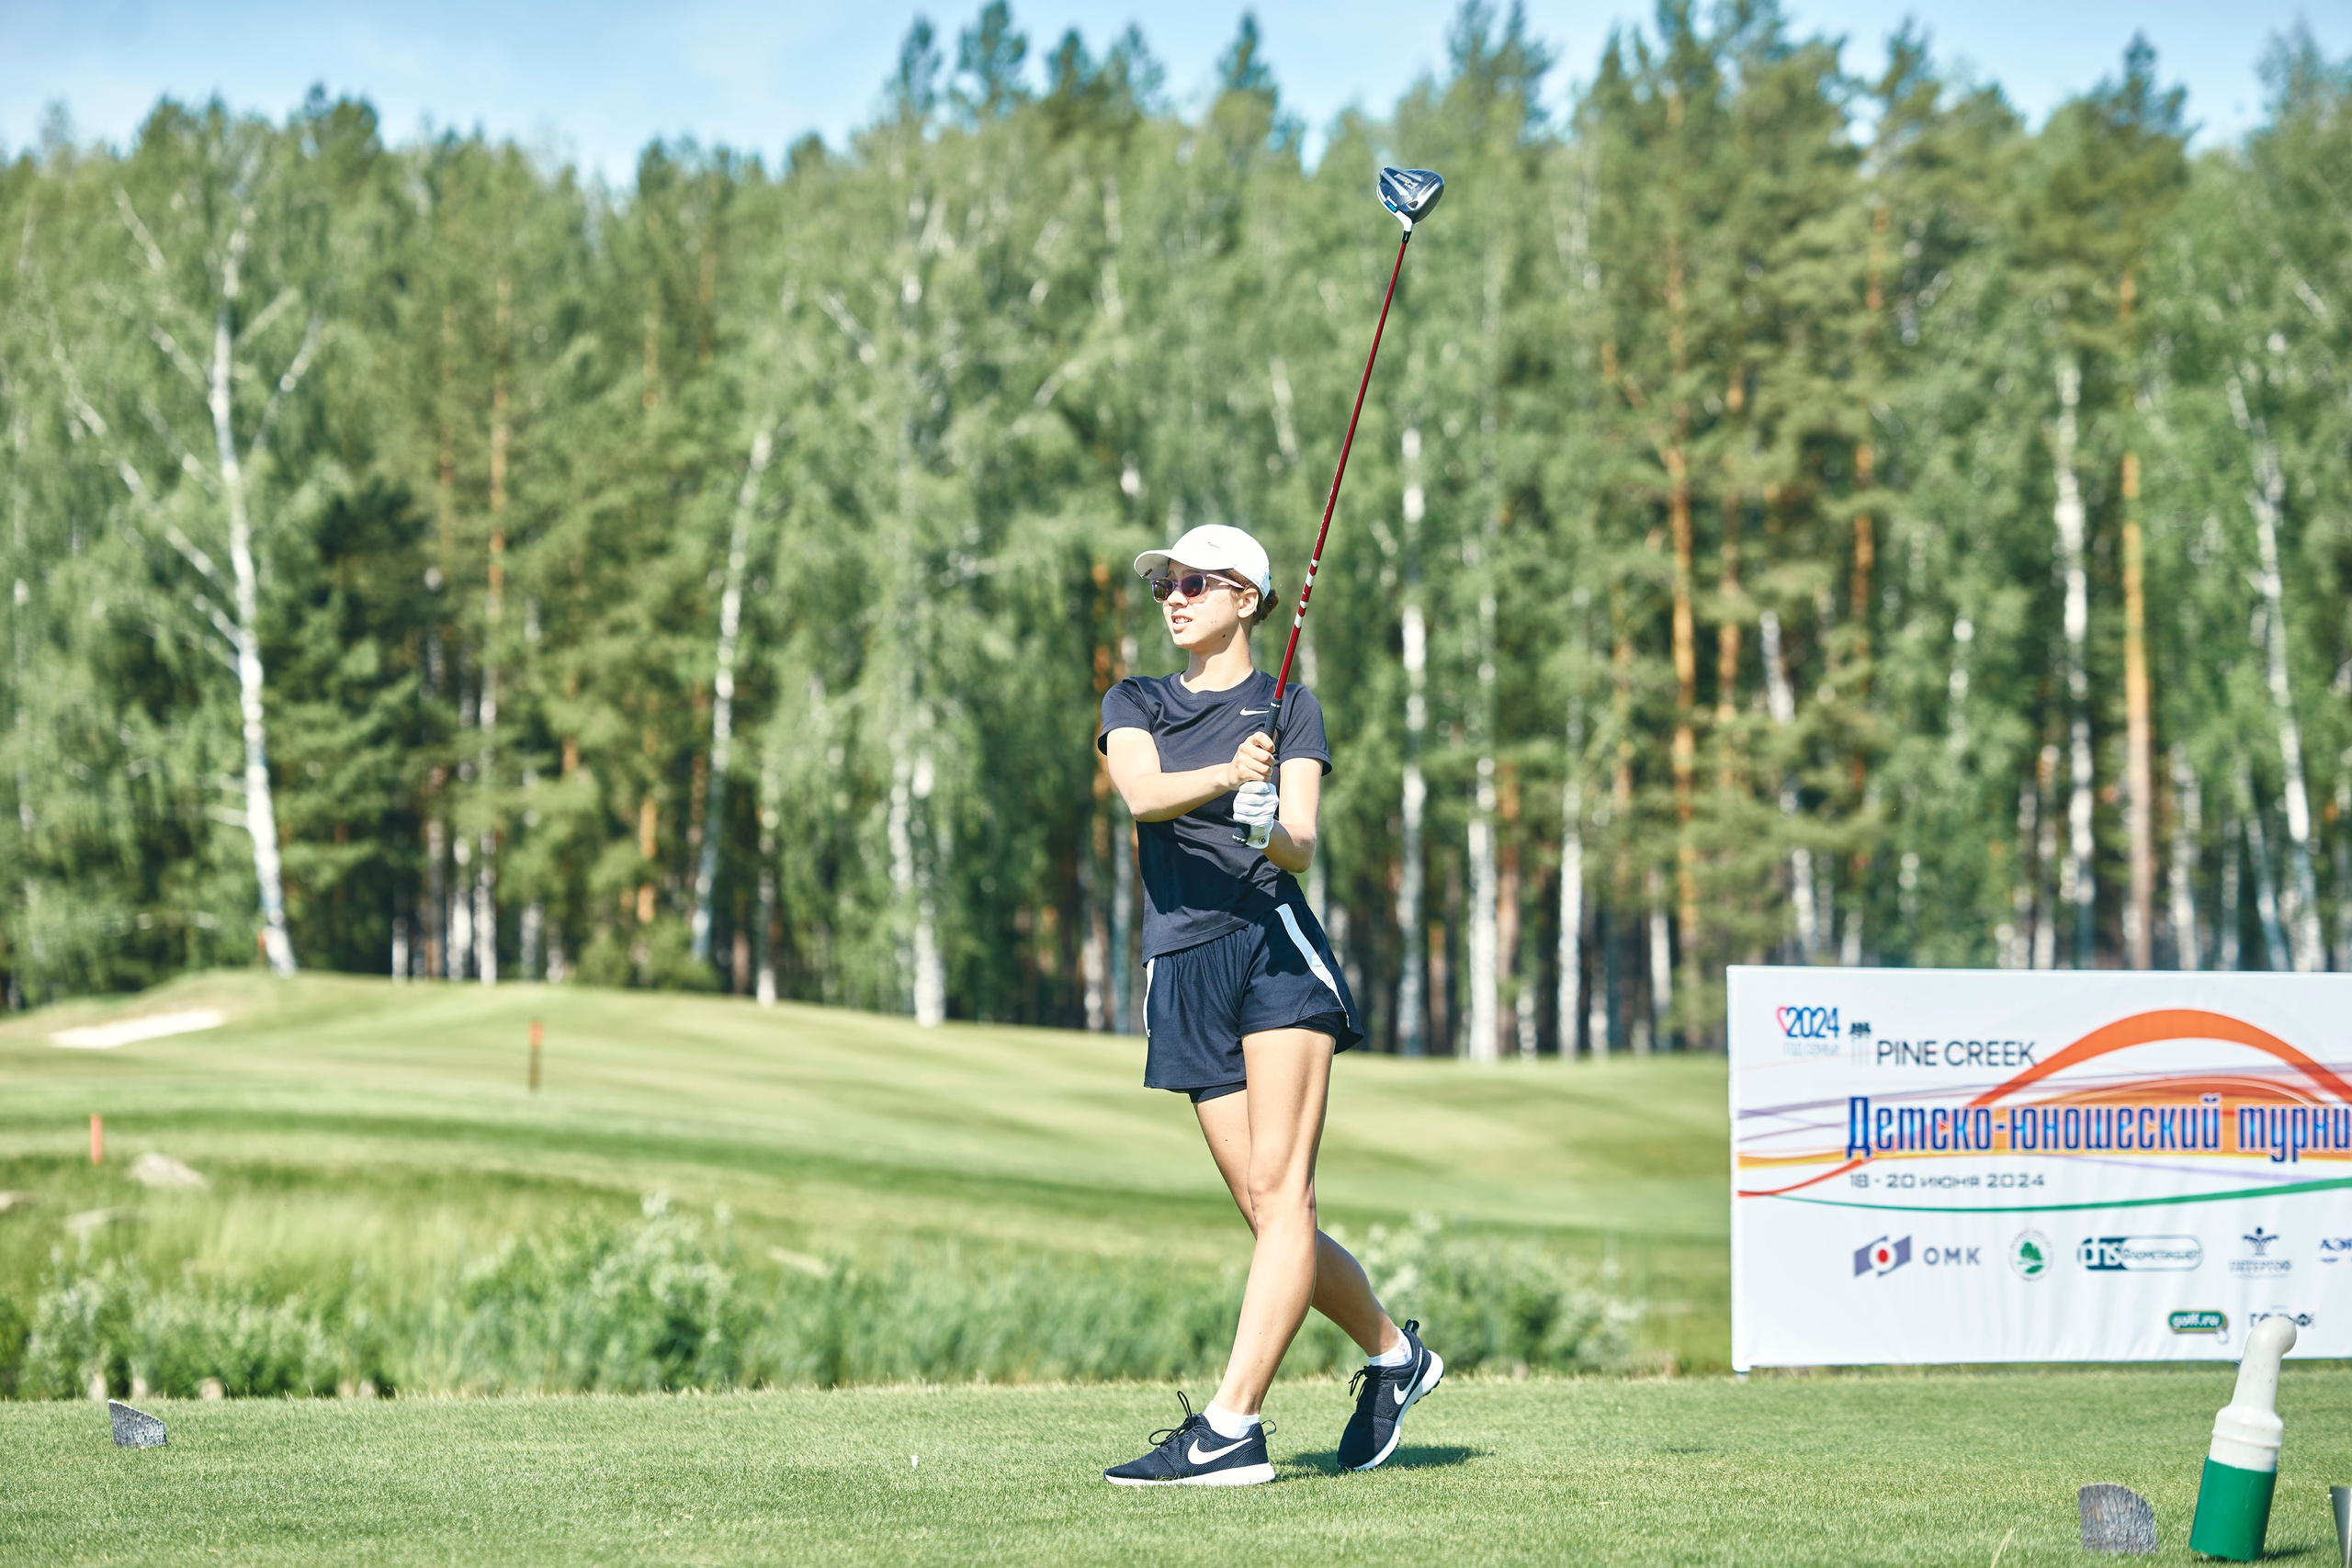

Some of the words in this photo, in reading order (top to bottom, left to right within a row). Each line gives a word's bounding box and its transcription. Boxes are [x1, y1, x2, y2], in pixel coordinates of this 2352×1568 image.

[1786, 1007, 1839, 1037] 2024
[1877, 1040, 1938, 1066] PINE
[1944, 1040, 2037, 1066] CREEK
[1847, 1096, 2220, 1159] Детско-юношеский
[1850, 1173, 1869, 1189] 18
[1886, 1173, 1915, 1189] 20
[1986, 1173, 2045, 1189] 2024
[1923, 1247, 1981, 1266] ОМК
